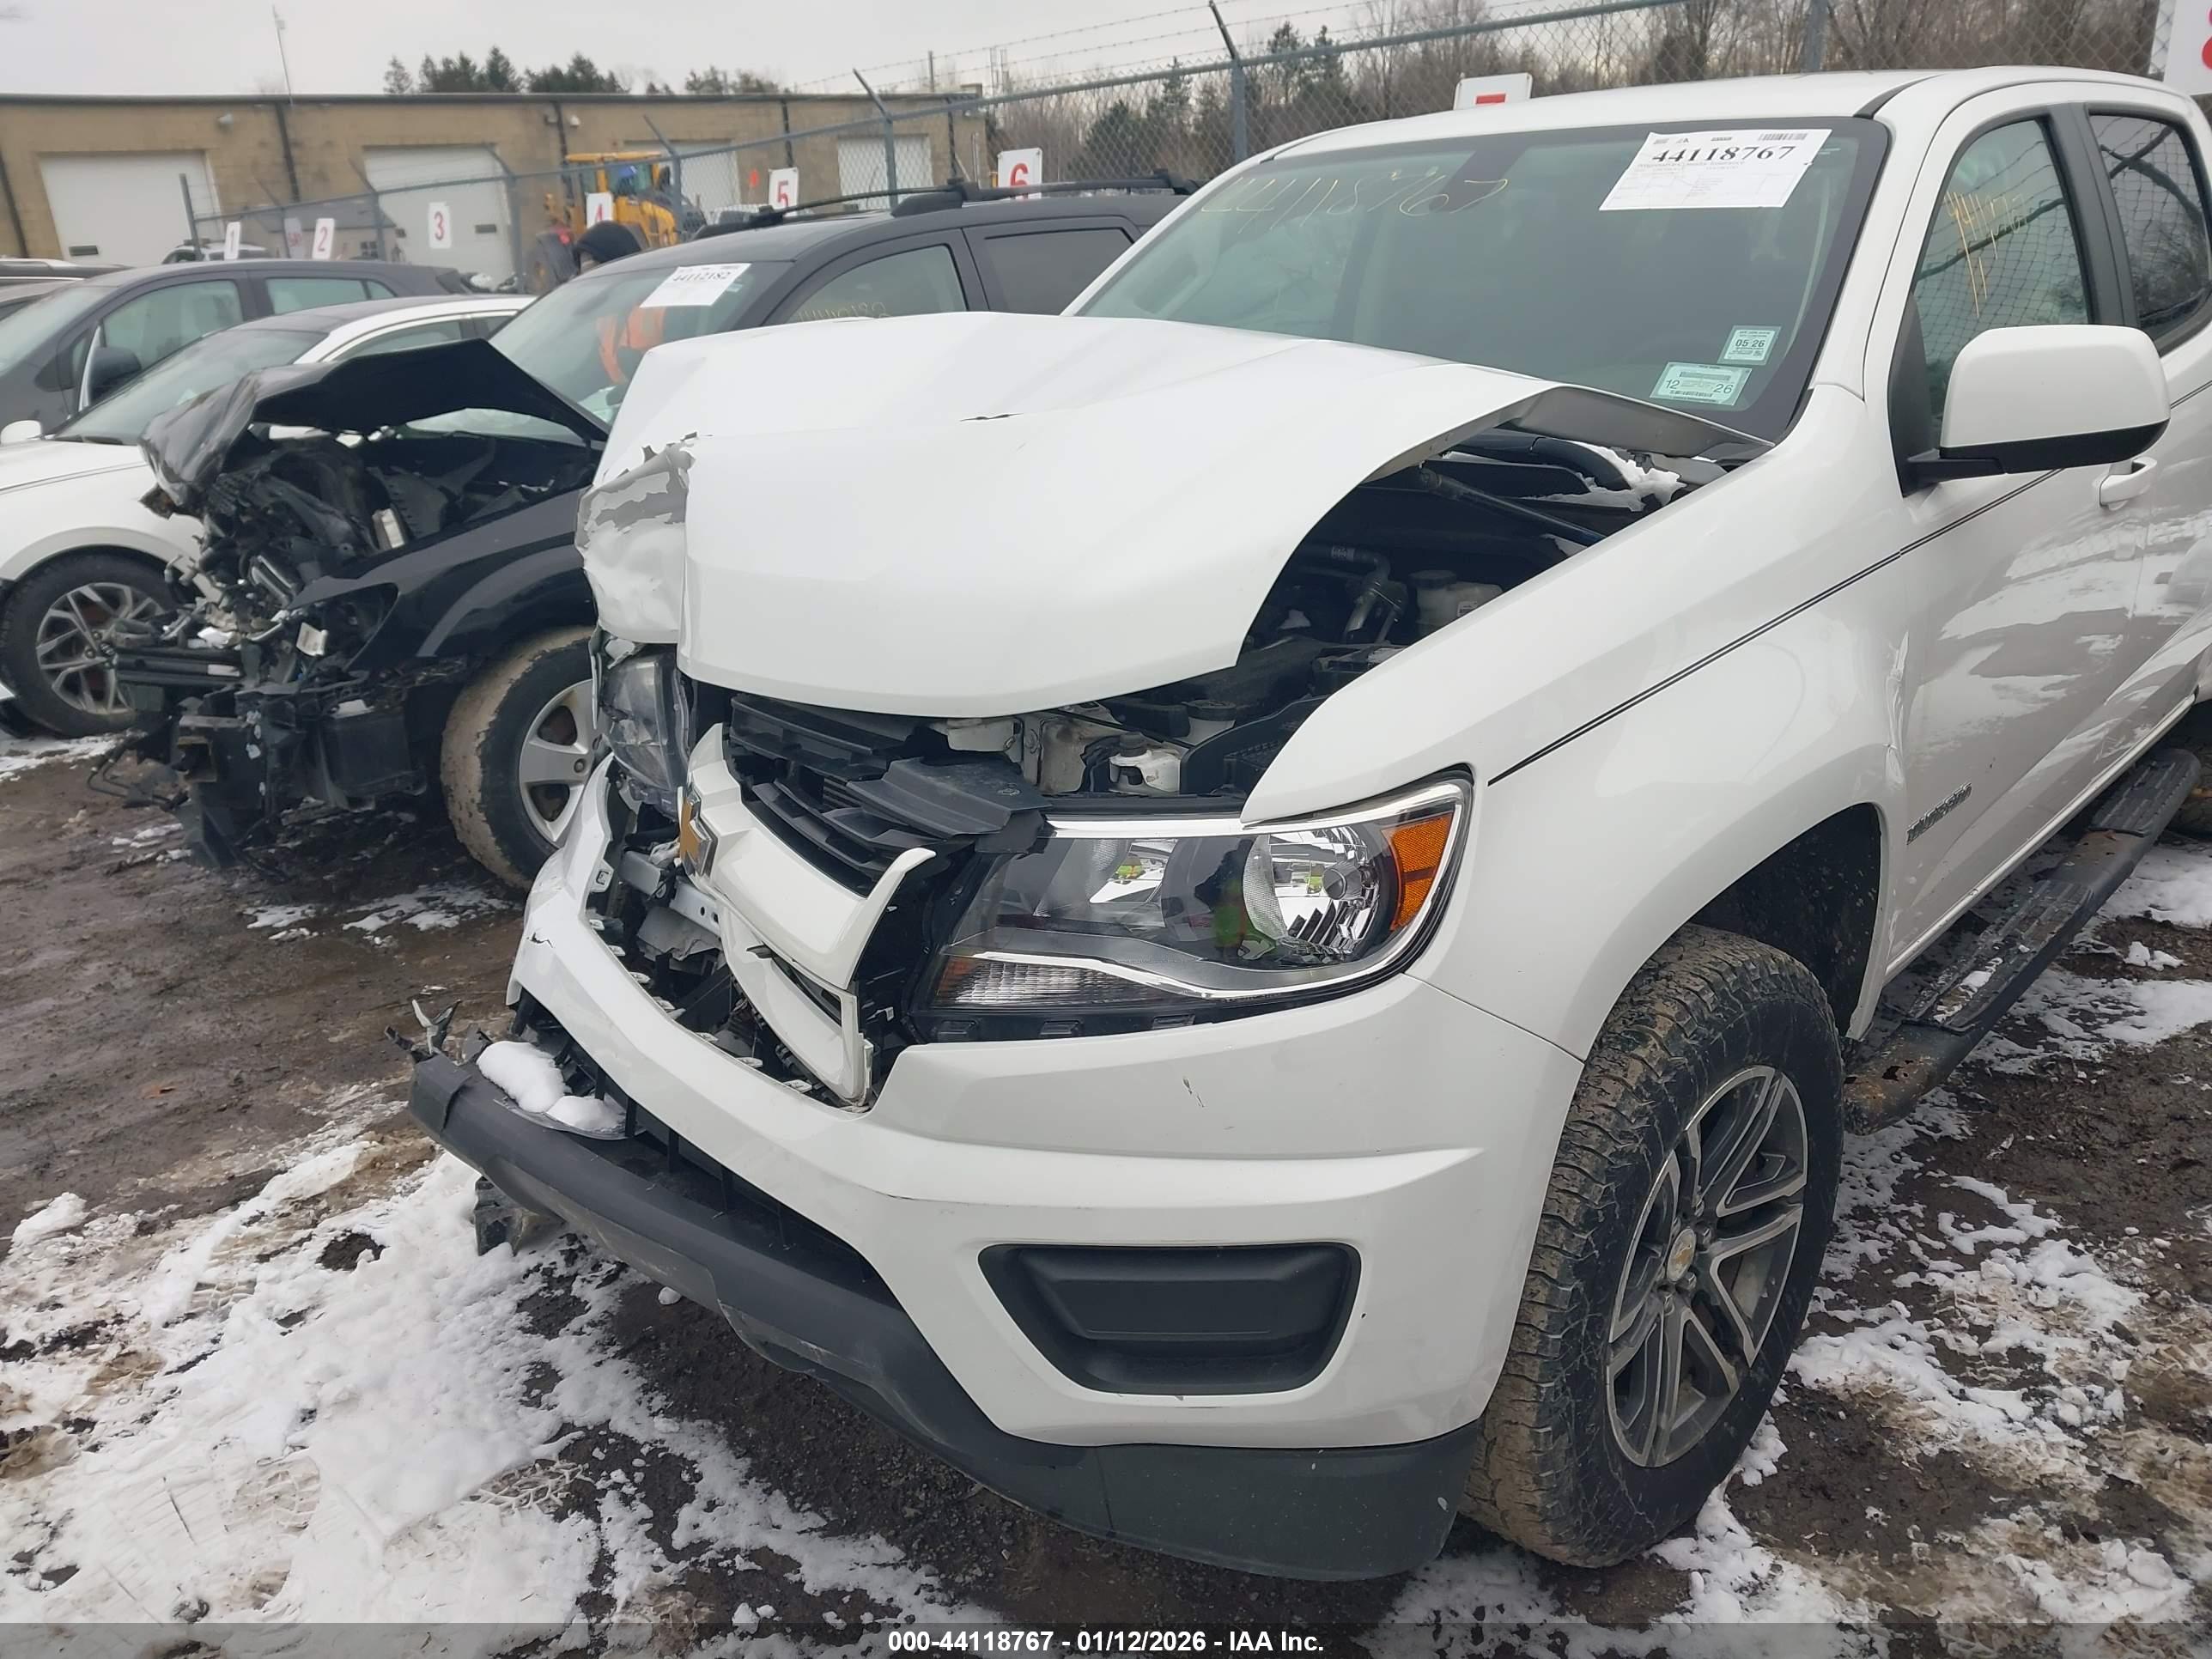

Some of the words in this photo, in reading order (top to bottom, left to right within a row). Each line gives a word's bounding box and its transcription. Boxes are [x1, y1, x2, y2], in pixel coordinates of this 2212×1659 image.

[1651, 145, 1796, 162] 44118767
[776, 180, 789, 208] 5
[434, 211, 445, 240] 3
[228, 230, 236, 252] 1
[319, 226, 328, 252] 2
[1735, 338, 1748, 348] 05
[1751, 339, 1765, 348] 26
[1666, 379, 1680, 390] 12
[1713, 383, 1734, 394] 26
